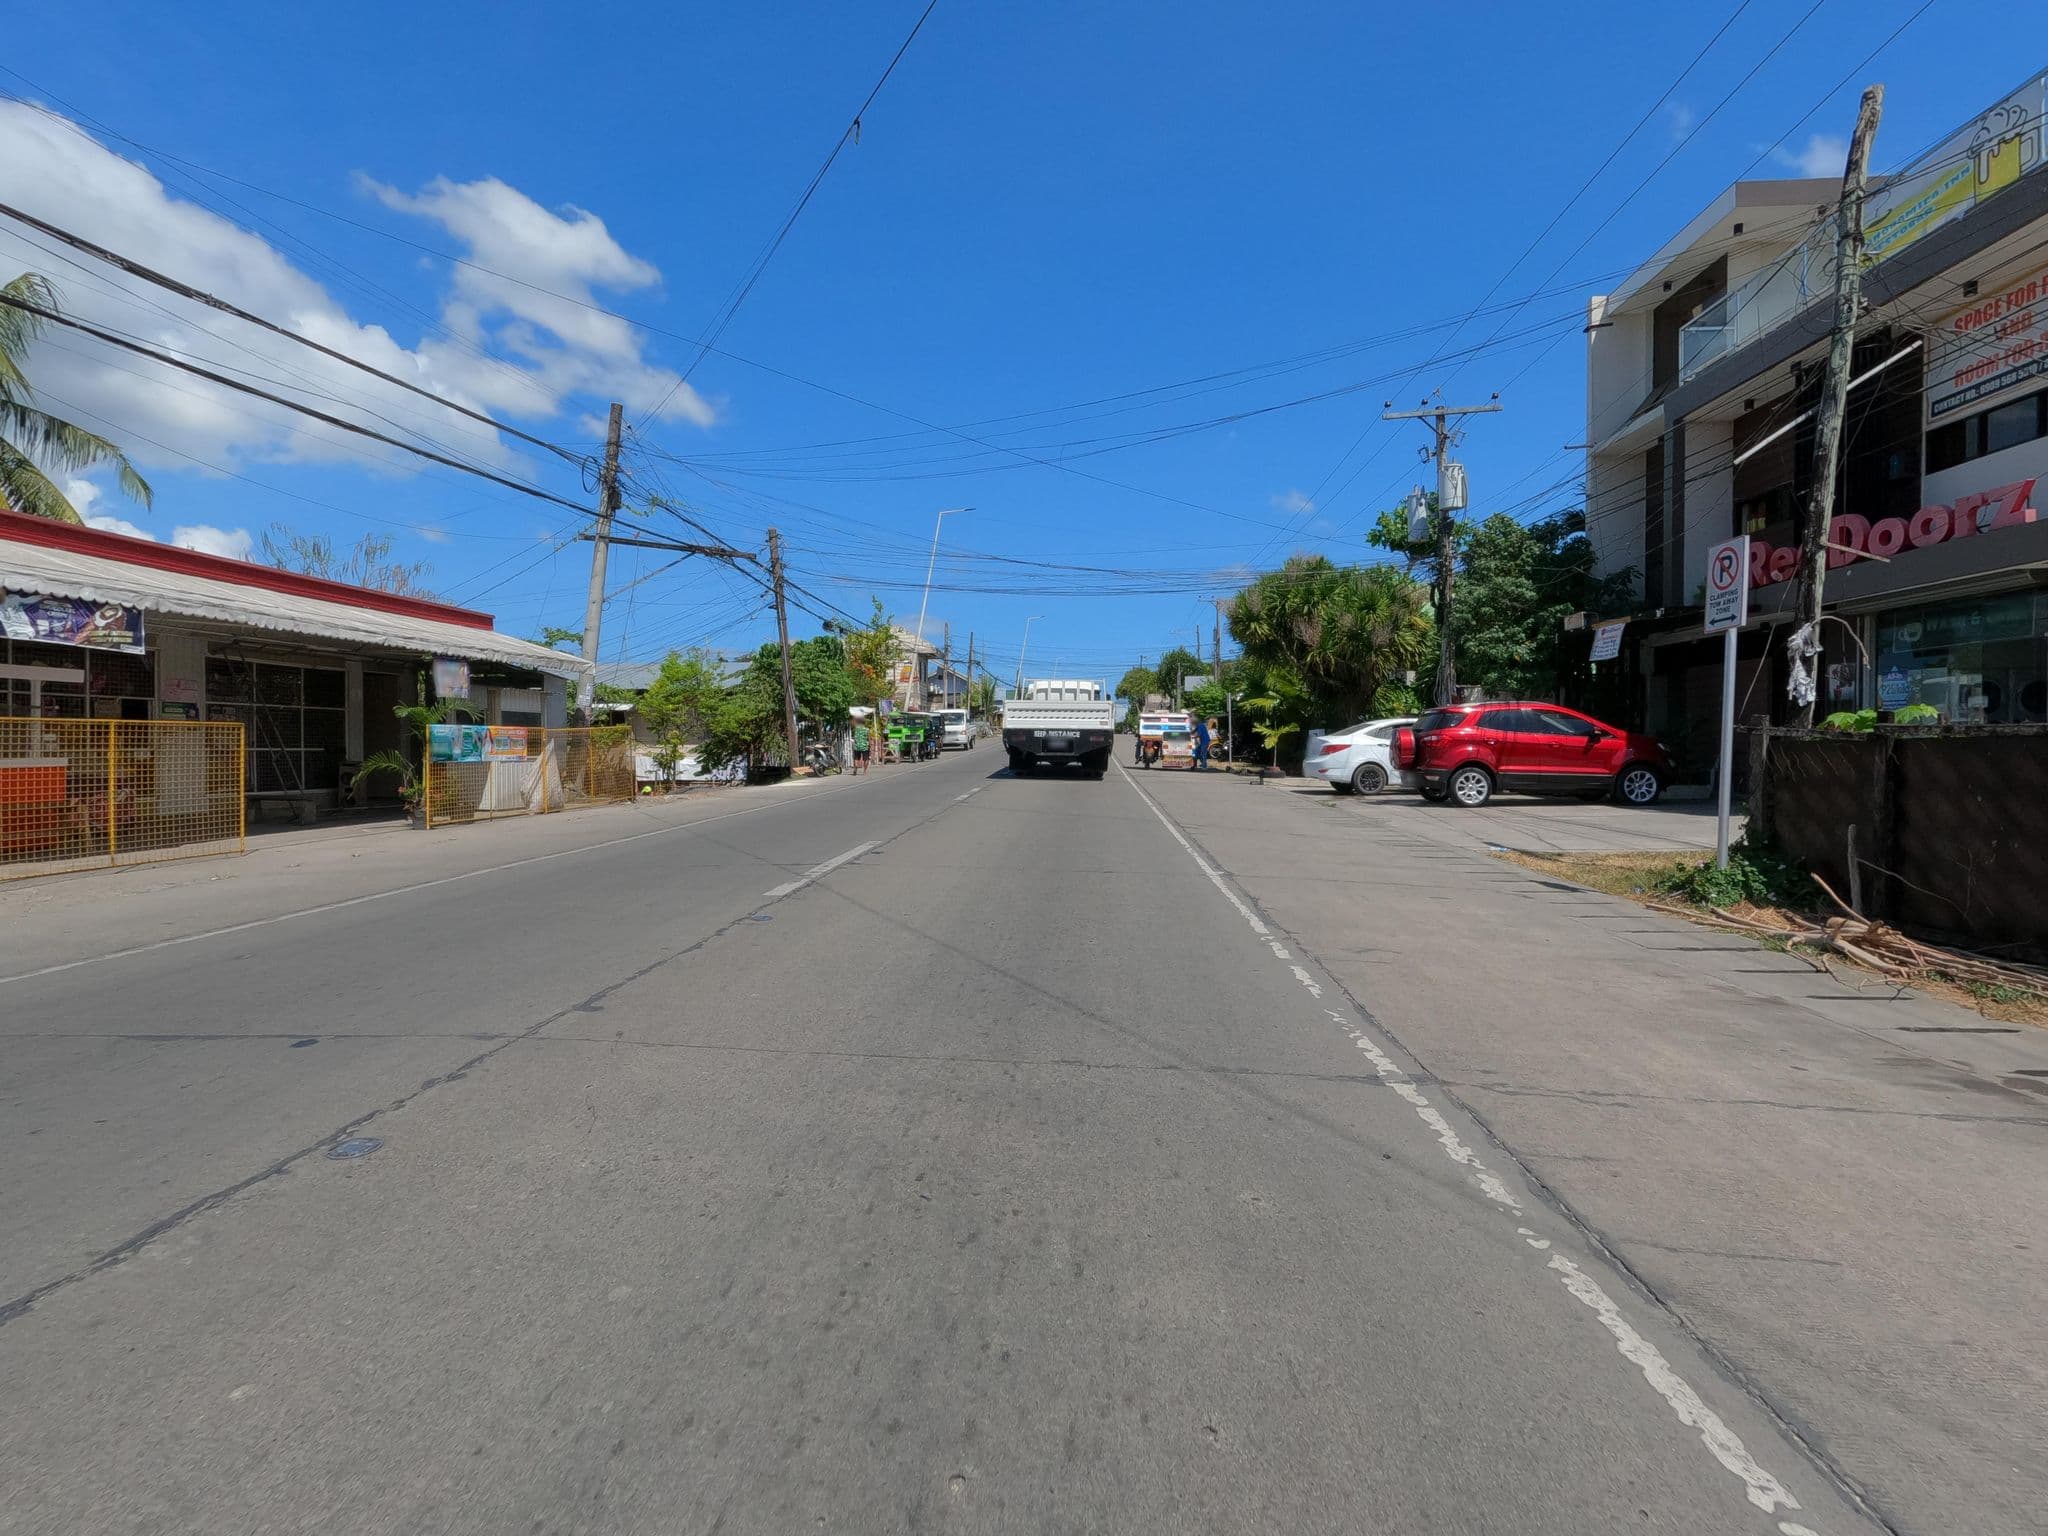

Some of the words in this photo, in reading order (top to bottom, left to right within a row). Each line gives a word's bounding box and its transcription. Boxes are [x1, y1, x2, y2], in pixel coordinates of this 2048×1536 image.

[1954, 297, 2002, 336] SPACE
[2006, 281, 2037, 312] FOR
[1954, 352, 2000, 388] ROOM
[2004, 338, 2034, 366] FOR
[1749, 479, 2037, 589] ReDoorz
[1709, 588, 1739, 601] CLAMPING
[1723, 595, 1738, 606] AWAY
[1716, 606, 1731, 615] ZONE
[1048, 730, 1081, 738] DISTANCE
